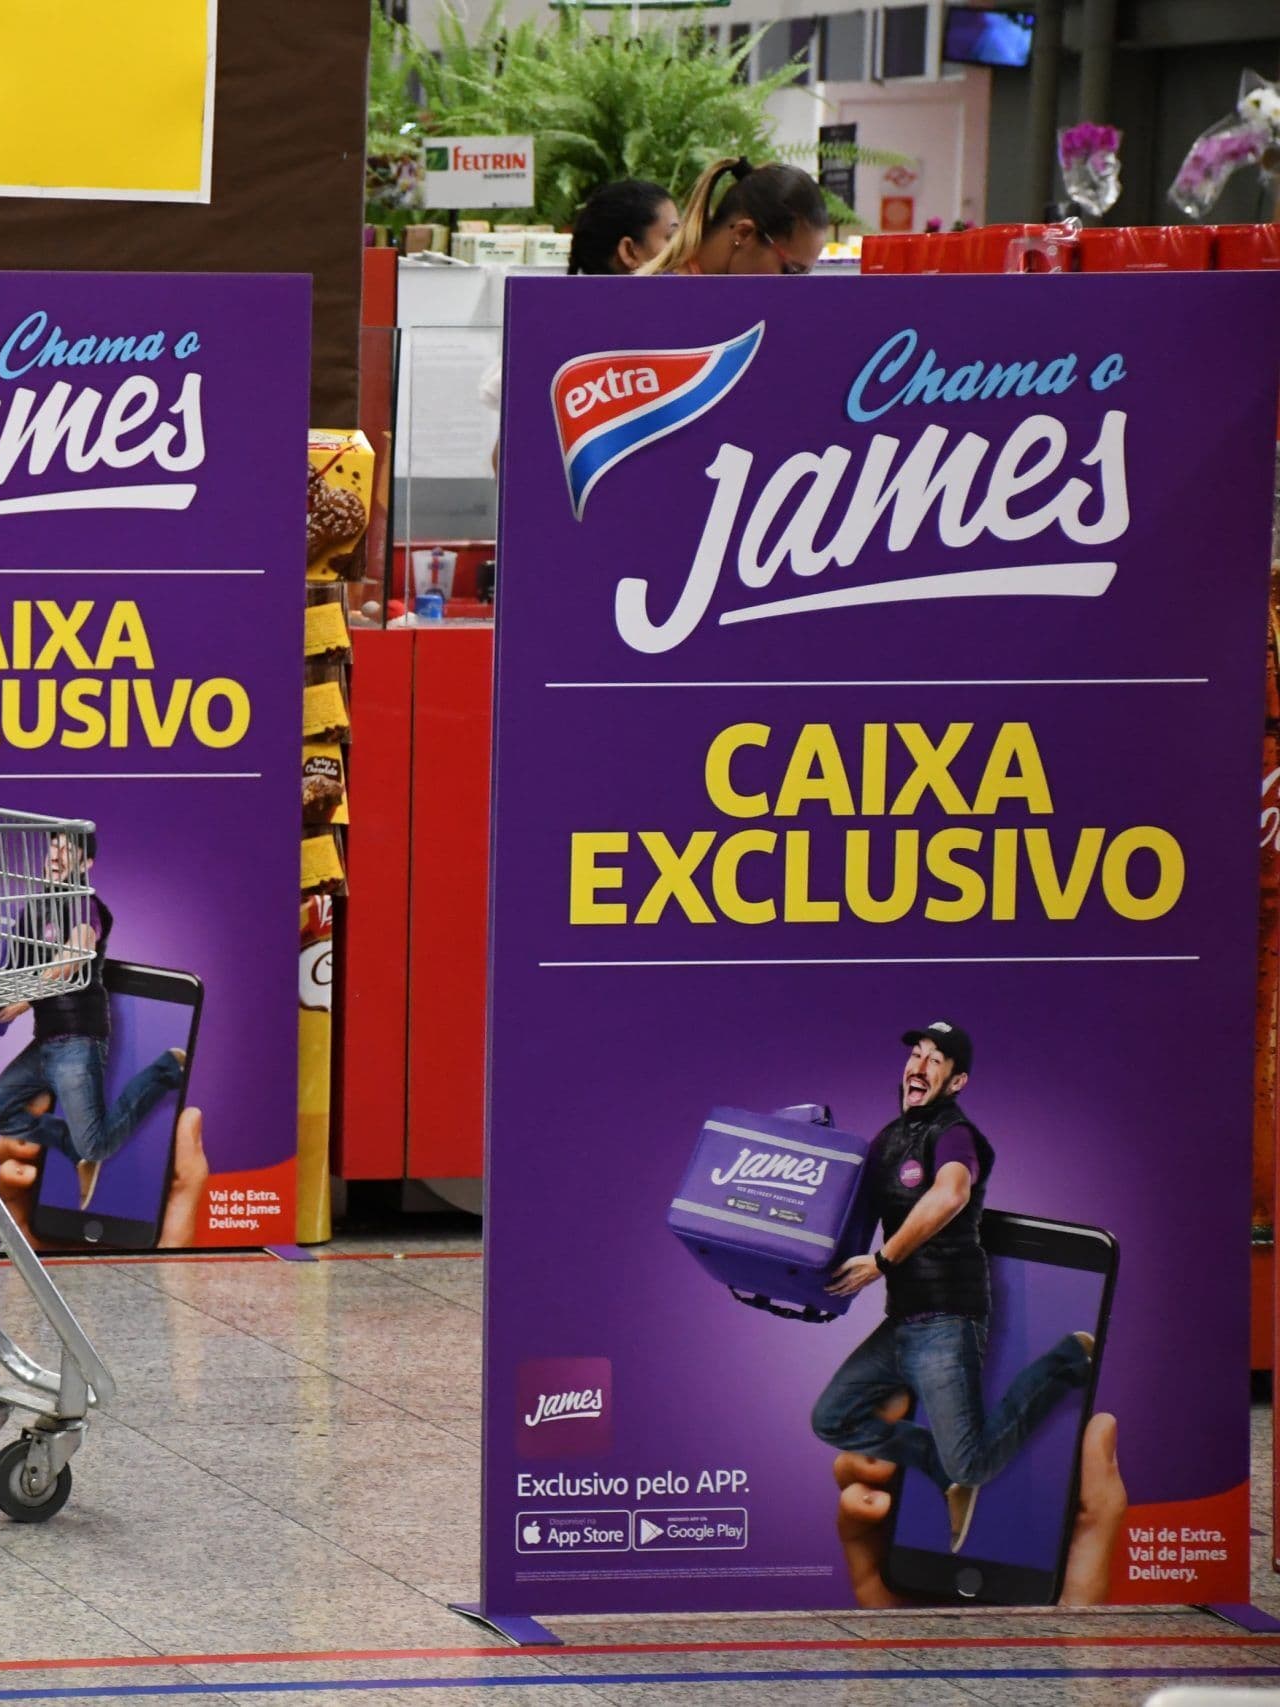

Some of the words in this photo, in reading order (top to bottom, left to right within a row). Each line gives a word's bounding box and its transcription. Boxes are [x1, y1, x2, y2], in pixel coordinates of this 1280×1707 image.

[174, 329, 201, 359] o
[847, 328, 1076, 423] Chama
[1090, 352, 1127, 392] o
[564, 363, 660, 419] extra
[615, 410, 1130, 653] James
[705, 722, 1054, 818] CAIXA
[569, 826, 1185, 926] EXCLUSIVO
[711, 1148, 829, 1186] James
[209, 1190, 228, 1201] Vai
[230, 1190, 245, 1201] de
[246, 1190, 280, 1201] Extra.
[209, 1204, 228, 1215] Vai
[230, 1204, 245, 1215] de
[246, 1204, 281, 1216] James
[209, 1217, 260, 1230] Delivery.
[525, 1388, 603, 1427] James
[517, 1472, 629, 1497] Exclusivo
[636, 1471, 690, 1500] pelo
[696, 1470, 750, 1494] APP.
[547, 1528, 581, 1547] App
[583, 1526, 624, 1543] Store
[666, 1524, 715, 1541] Google
[717, 1523, 744, 1540] Play
[1129, 1528, 1154, 1542] Vai
[1157, 1528, 1177, 1542] de
[1181, 1528, 1226, 1542] Extra.
[1129, 1546, 1154, 1561] Vai
[1157, 1546, 1177, 1561] de
[1180, 1547, 1227, 1563] James
[1129, 1565, 1198, 1583] Delivery.
